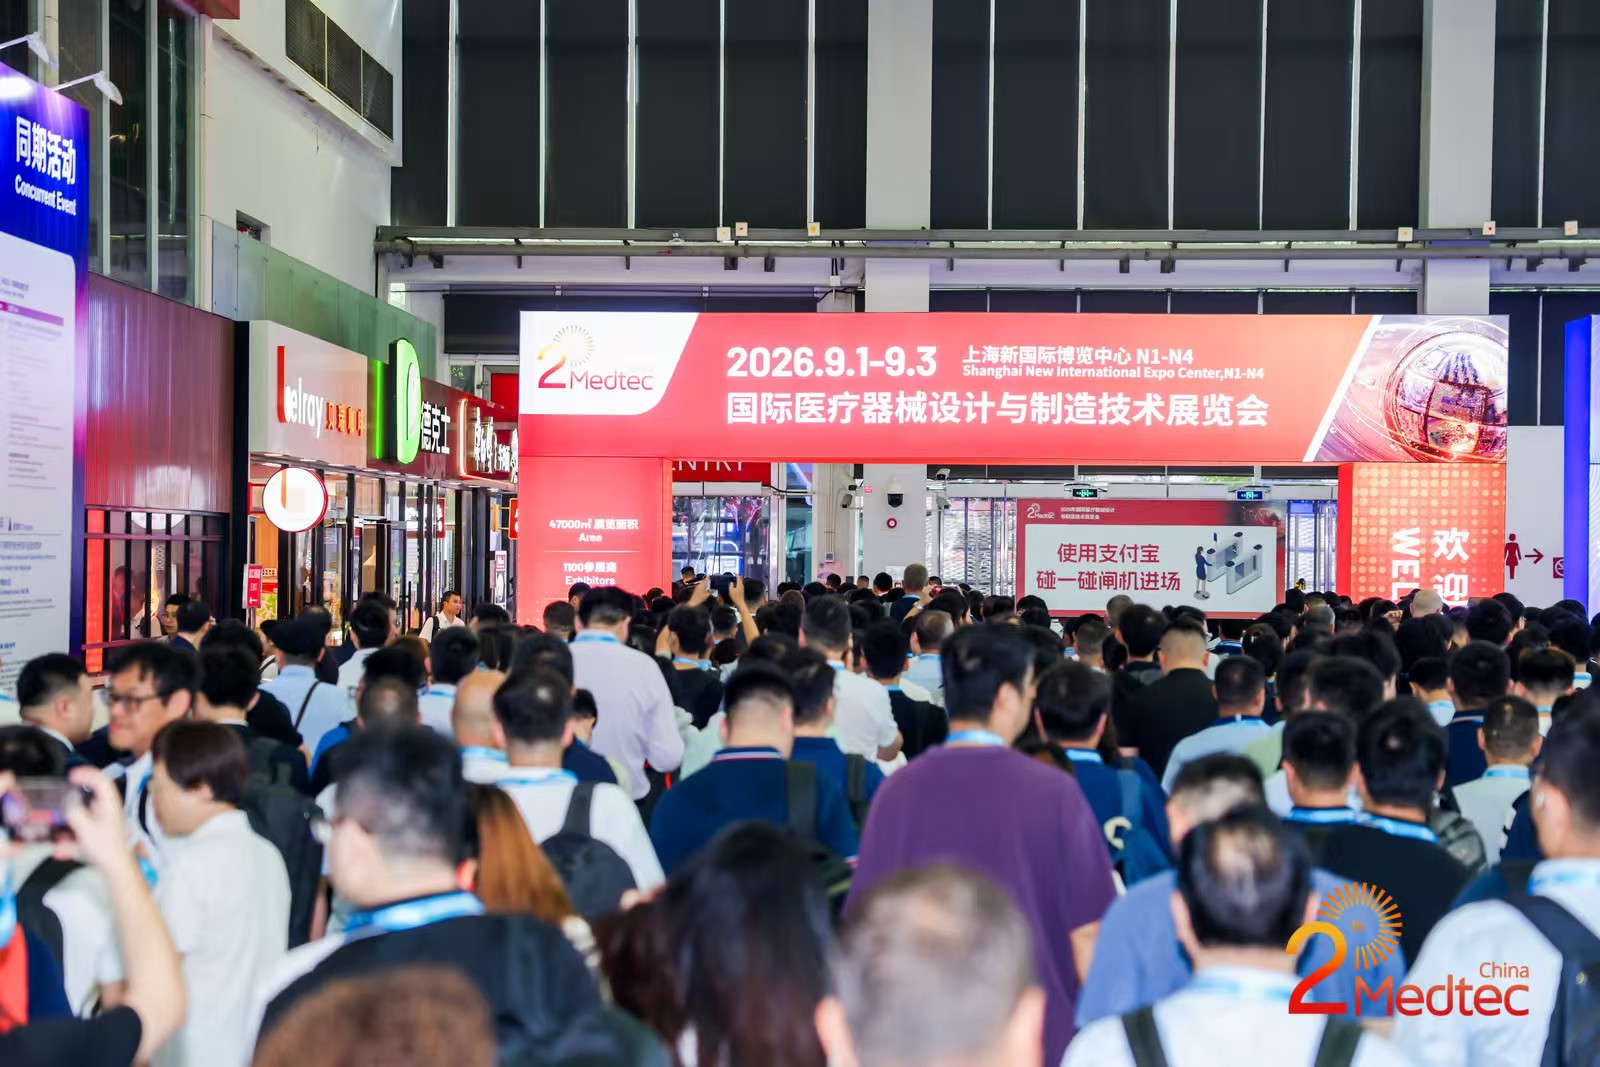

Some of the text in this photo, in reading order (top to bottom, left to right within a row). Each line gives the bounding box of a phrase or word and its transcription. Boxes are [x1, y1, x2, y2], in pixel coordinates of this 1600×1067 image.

[16, 116, 76, 185] 同期活动
[15, 174, 76, 216] Concurrent Event
[727, 346, 937, 377] 2026.9.1-9.3
[962, 345, 1194, 365] 上海新国际博览中心 N1-N4
[570, 370, 654, 390] Medtec
[962, 365, 1022, 379] Shanghai
[1025, 366, 1054, 377] New
[1056, 366, 1141, 378] International
[1144, 367, 1175, 381] Expo
[727, 391, 1269, 427] 国际医疗器械设计与制造技术展览会
[594, 518, 639, 530] 展览面积
[578, 533, 603, 542] Area
[1057, 543, 1160, 564] 使用支付宝
[563, 561, 617, 573] 1100参展商
[1433, 527, 1470, 605] 欢迎
[565, 575, 616, 585] Exhibitors
[1036, 571, 1181, 592] 碰一碰闸机进场
